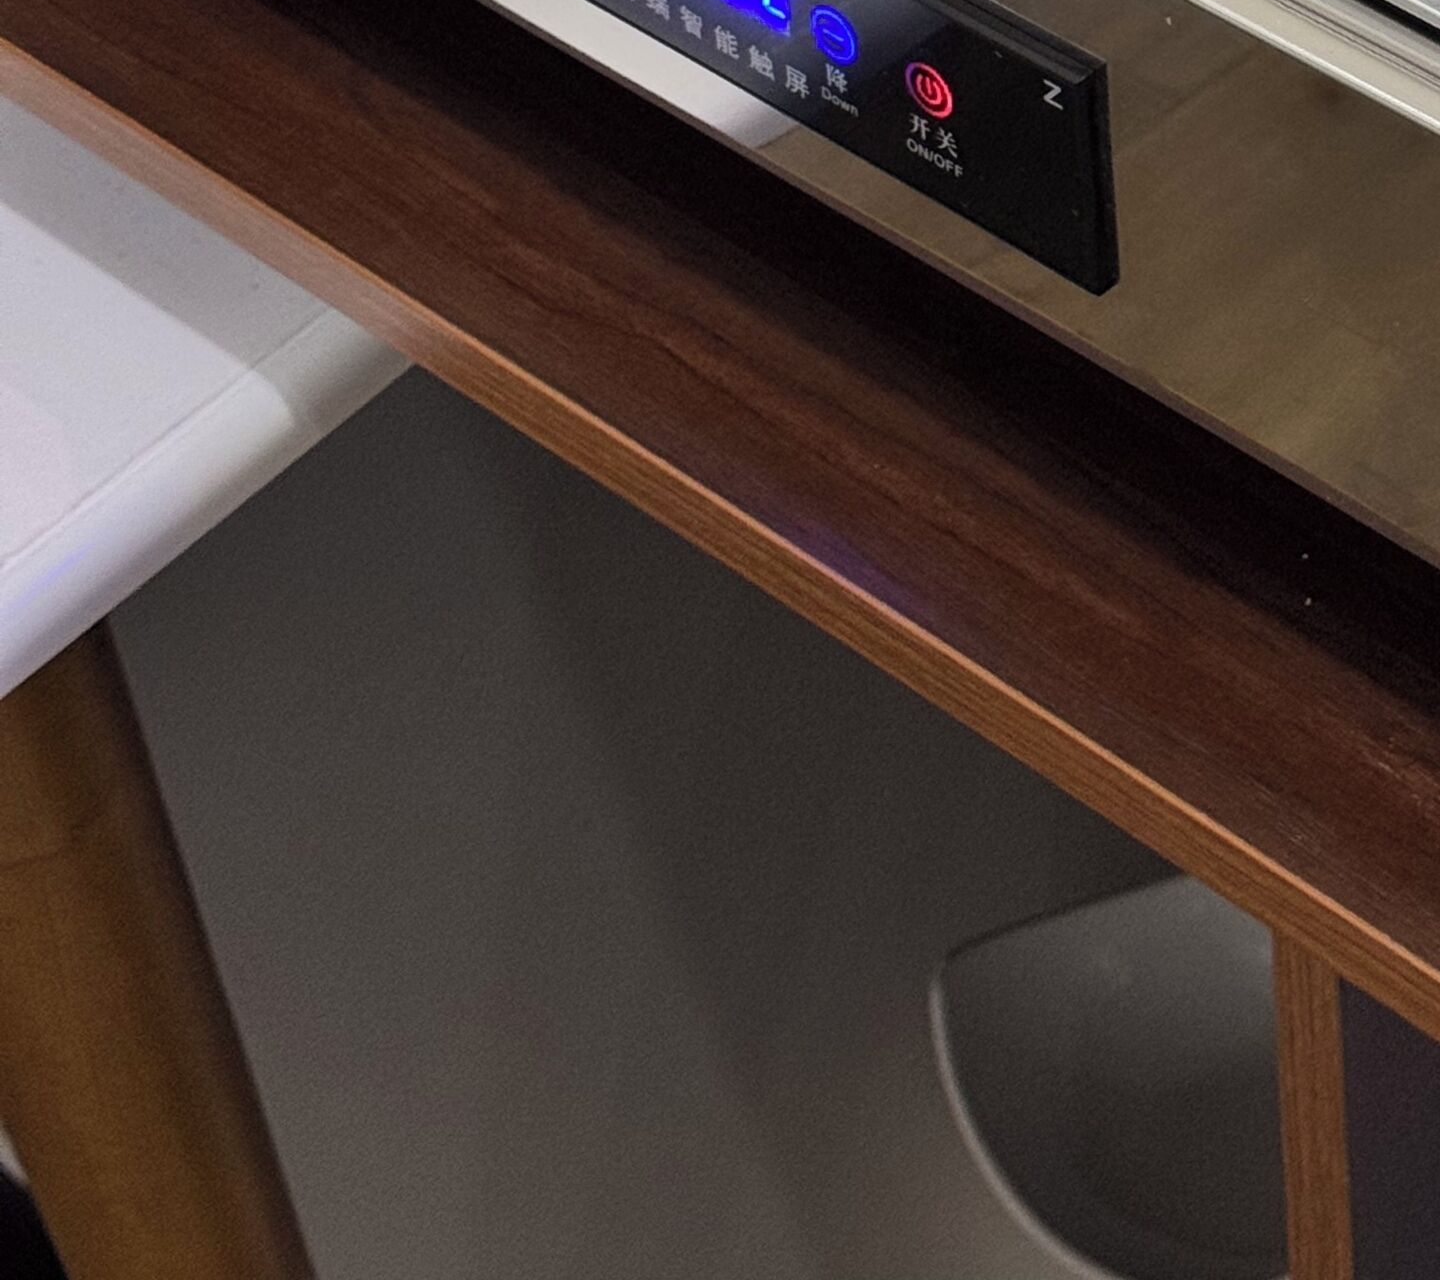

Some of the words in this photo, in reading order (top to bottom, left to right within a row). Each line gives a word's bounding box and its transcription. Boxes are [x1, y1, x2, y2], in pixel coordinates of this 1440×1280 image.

[824, 62, 848, 94] 降
[1042, 78, 1064, 111] Z
[821, 85, 860, 118] Down
[909, 113, 958, 158] 开关
[906, 137, 964, 178] ON/OFF
